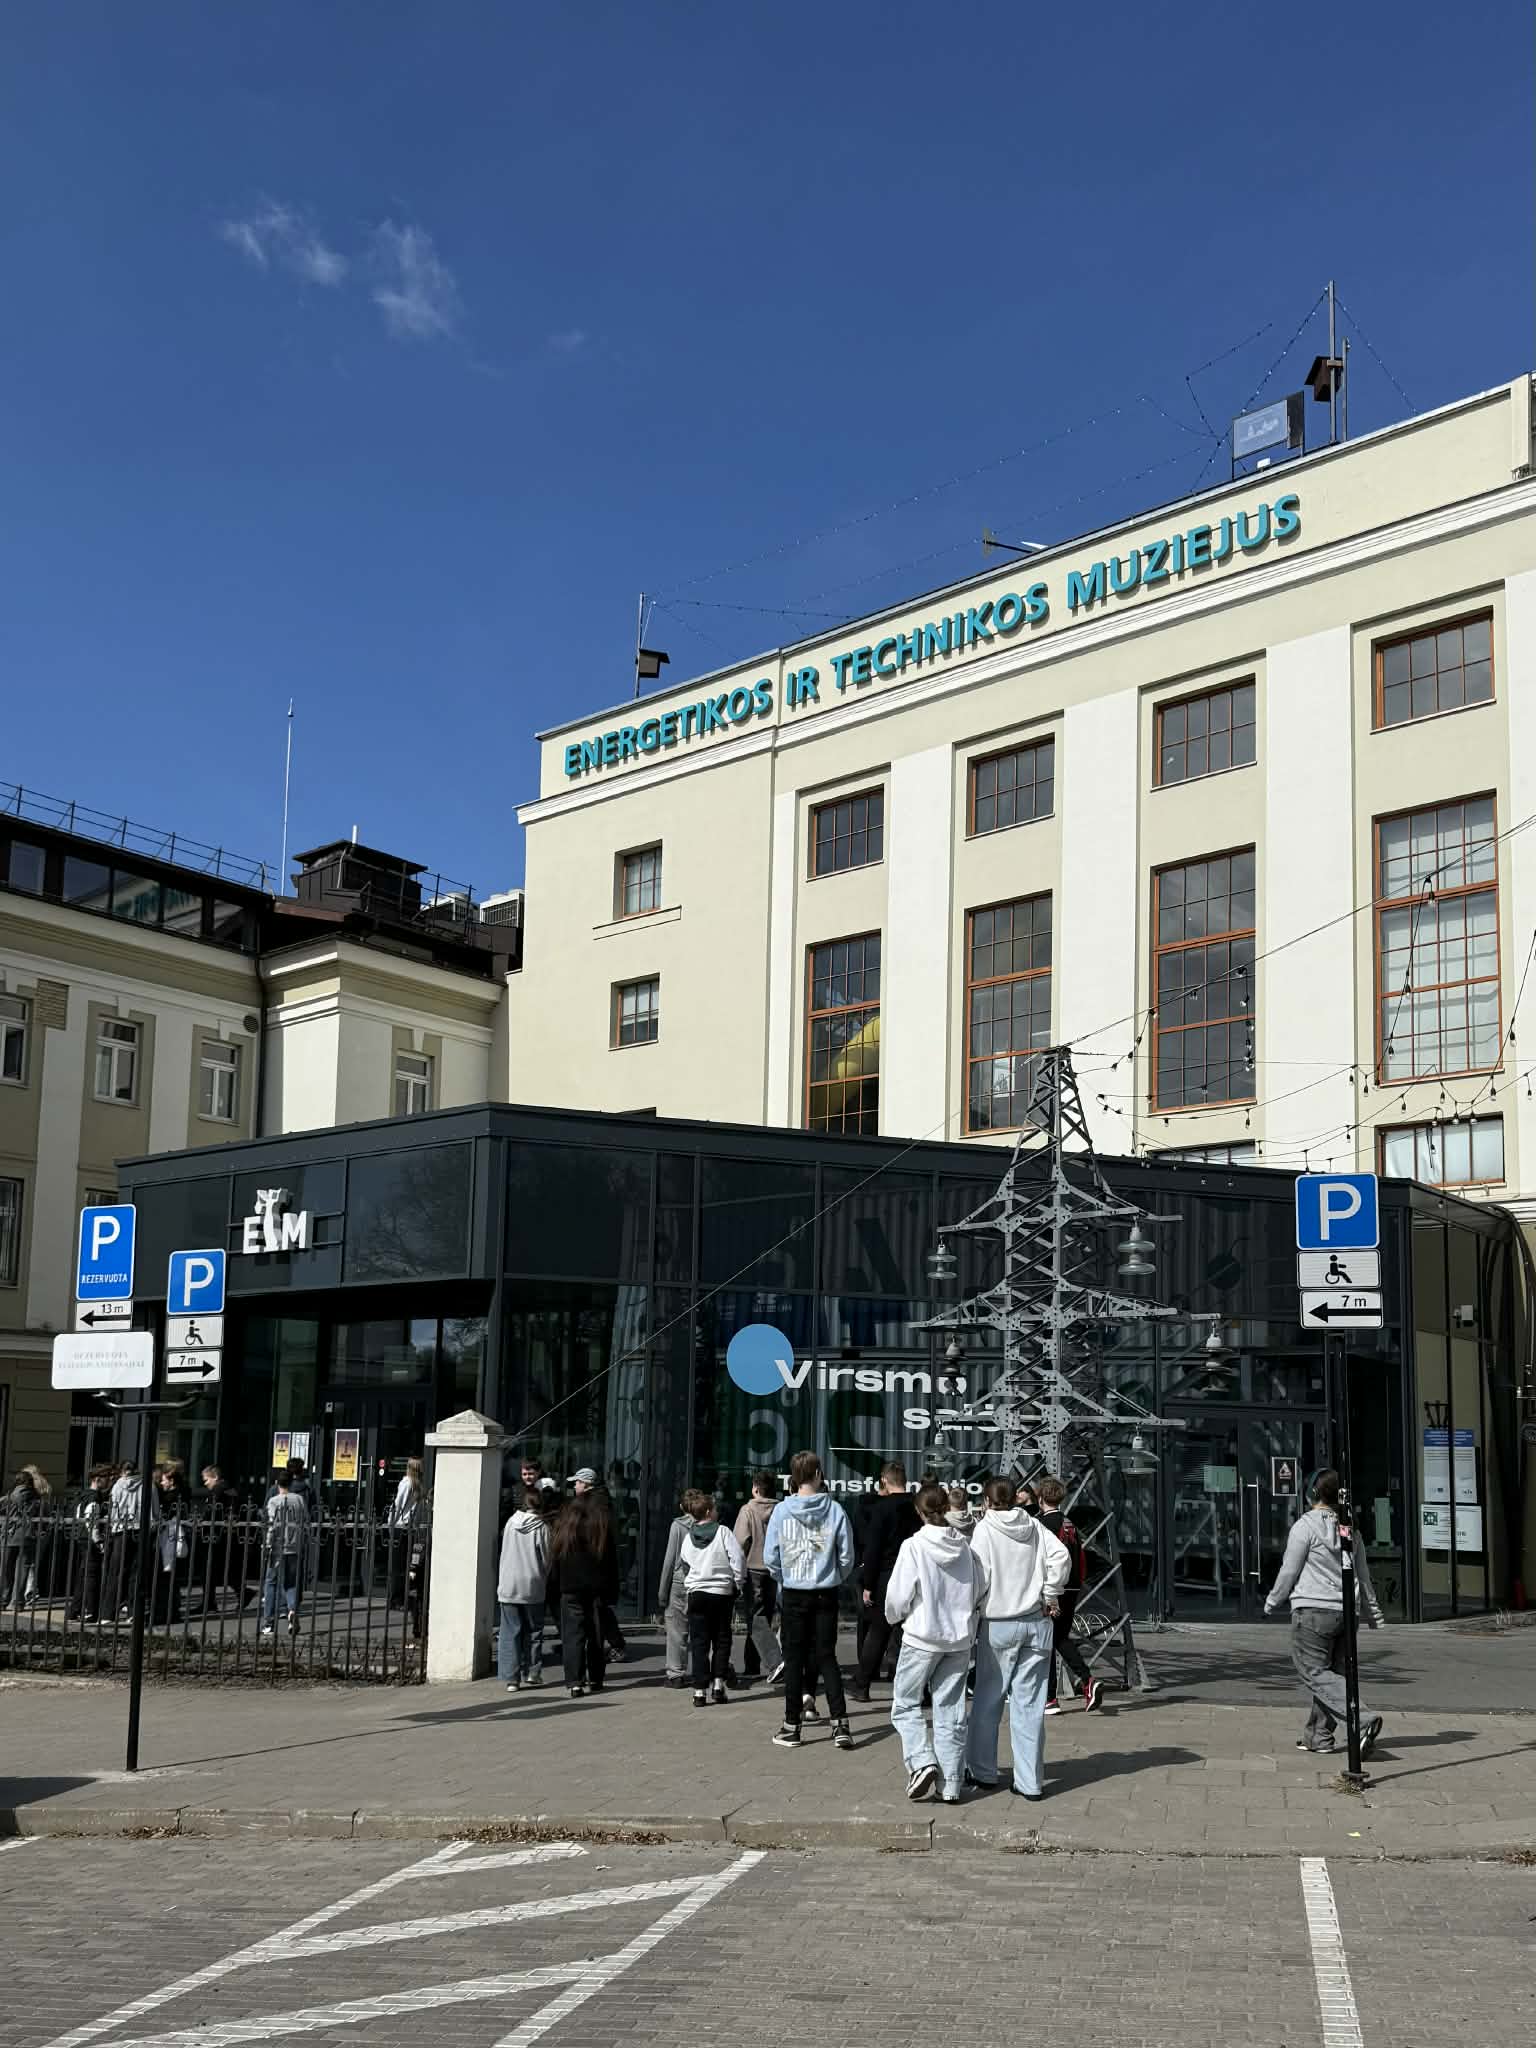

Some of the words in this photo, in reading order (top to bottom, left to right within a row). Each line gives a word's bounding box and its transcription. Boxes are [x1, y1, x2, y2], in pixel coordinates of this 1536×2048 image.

[564, 678, 773, 777] ENERGETIKOS
[787, 666, 819, 706] IR
[830, 582, 1049, 690] TECHNIKOS
[1067, 493, 1301, 610] MUZIEJUS
[1319, 1182, 1362, 1241] P
[92, 1215, 121, 1261] P
[183, 1257, 215, 1307] P
[1341, 1295, 1350, 1308] 7
[1354, 1298, 1367, 1308] m
[101, 1303, 113, 1314] 13
[114, 1305, 124, 1313] m
[179, 1355, 186, 1366] 7
[187, 1357, 197, 1366] m
